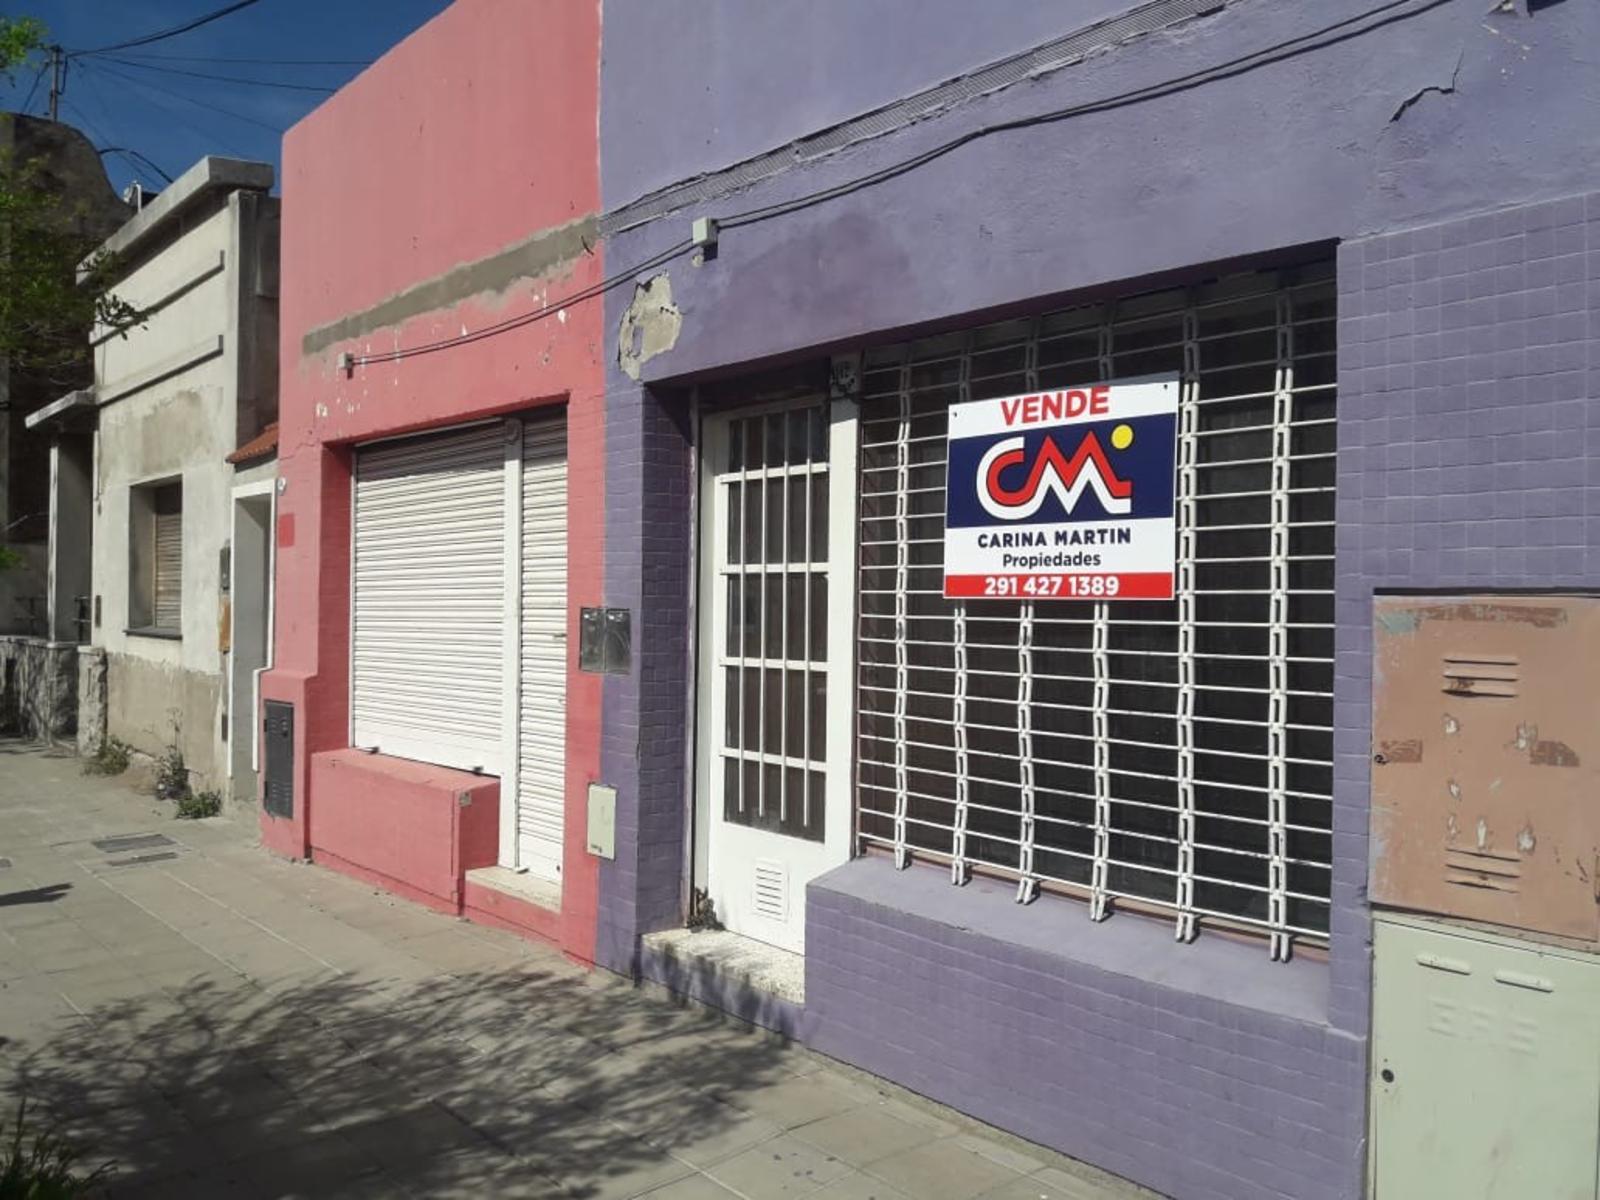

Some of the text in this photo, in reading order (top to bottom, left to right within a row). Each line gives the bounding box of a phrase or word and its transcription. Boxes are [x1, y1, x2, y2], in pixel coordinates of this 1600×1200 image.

[1001, 386, 1110, 426] VENDE
[976, 431, 1132, 520] CM
[977, 528, 1131, 549] CARINA MARTIN
[1002, 552, 1101, 570] Propiedades
[984, 576, 1119, 596] 291 427 1389
